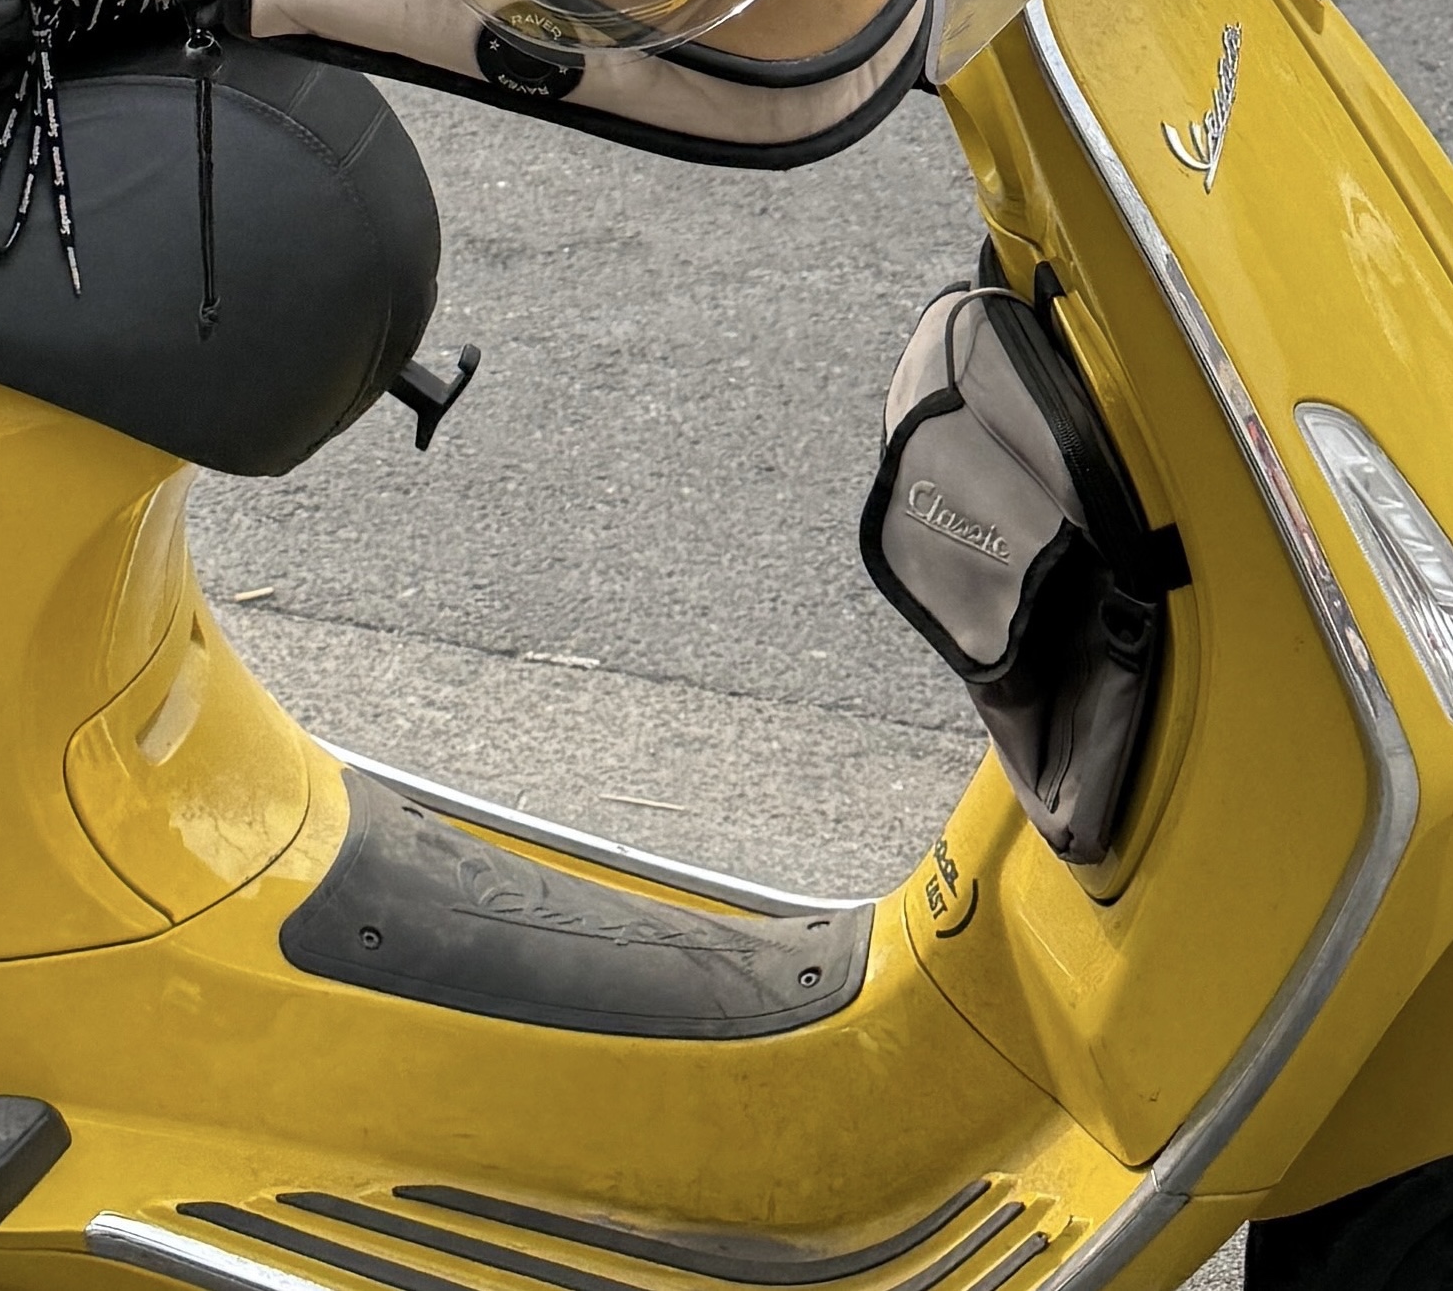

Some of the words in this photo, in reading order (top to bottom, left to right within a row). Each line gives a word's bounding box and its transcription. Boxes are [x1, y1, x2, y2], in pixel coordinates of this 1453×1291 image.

[510, 13, 563, 41] RAVER
[907, 479, 1011, 560] Classic
[925, 873, 948, 920] EAST
